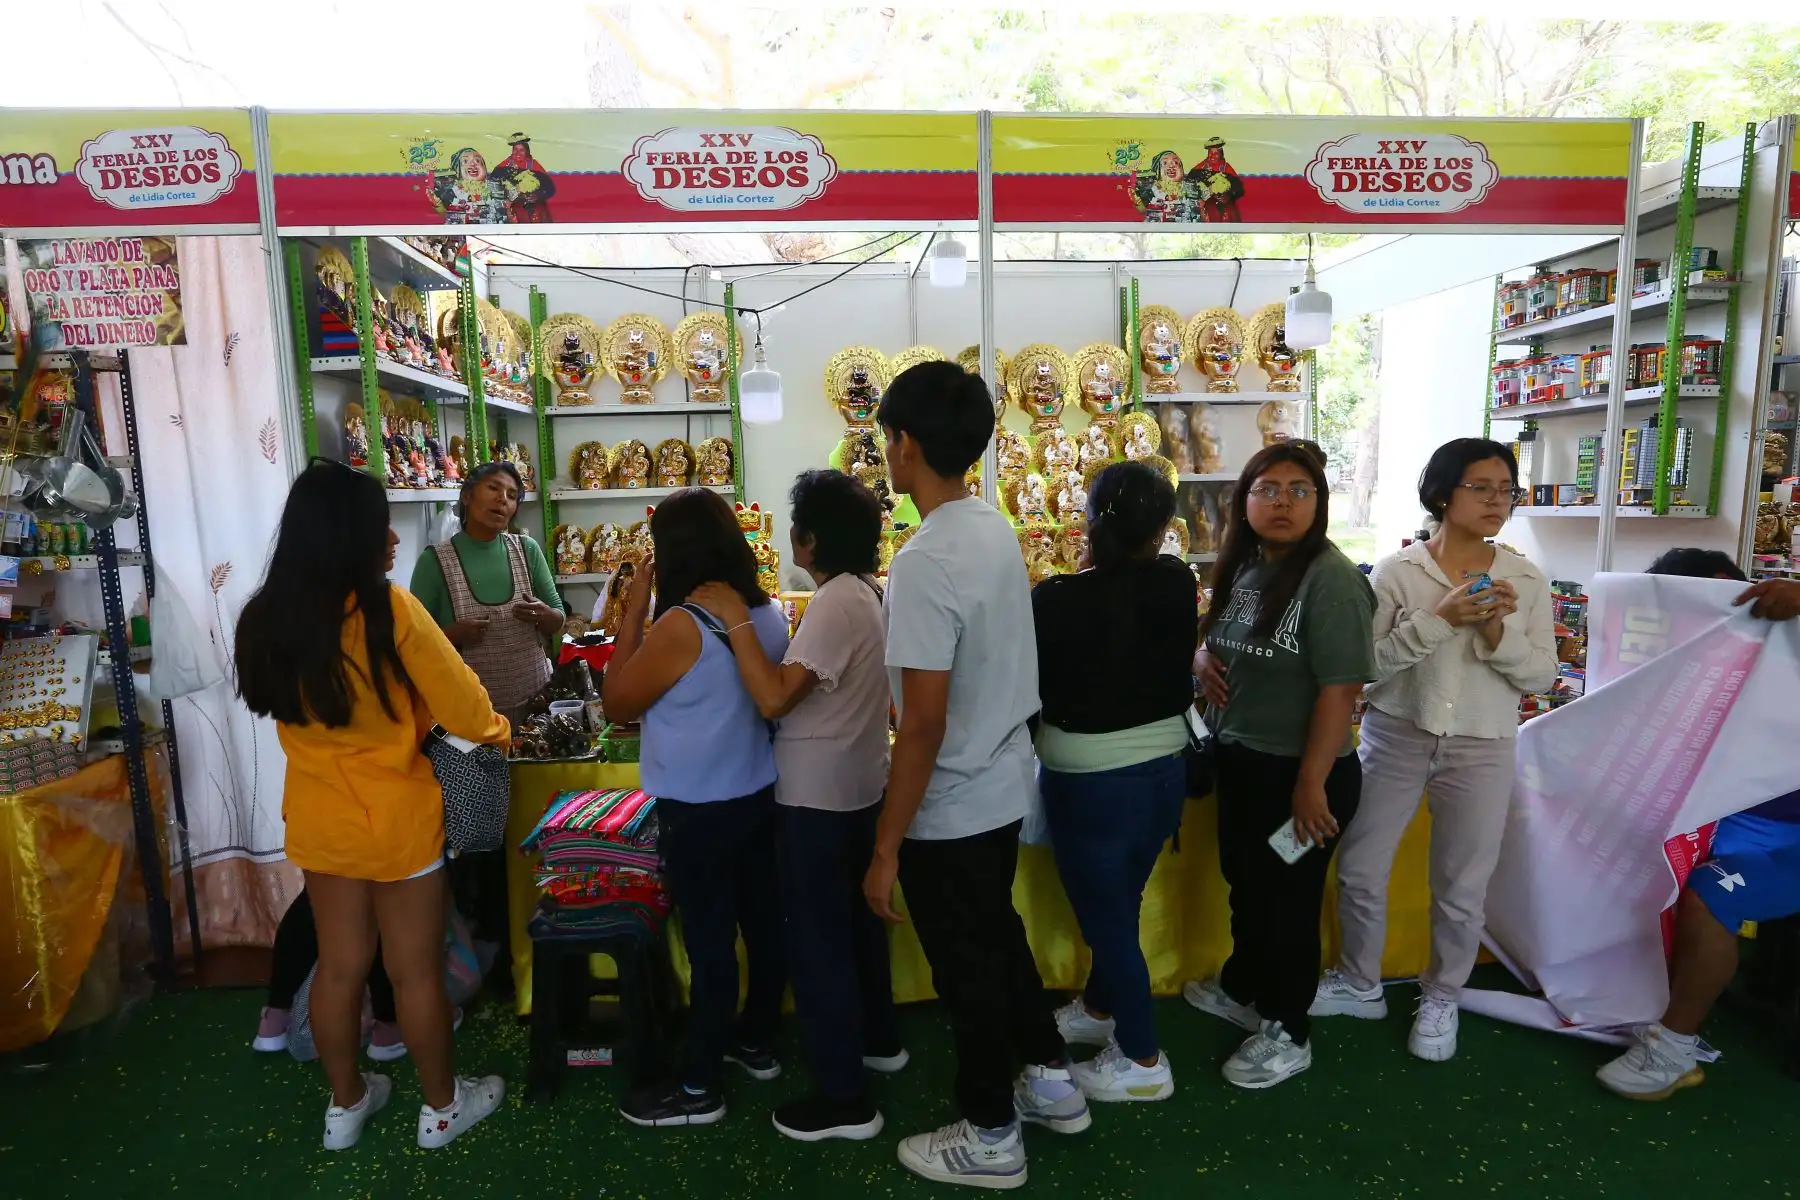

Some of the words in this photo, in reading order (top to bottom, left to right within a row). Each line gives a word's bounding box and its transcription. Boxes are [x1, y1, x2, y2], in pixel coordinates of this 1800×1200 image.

[130, 134, 173, 149] XXV
[700, 134, 753, 148] XXV
[1376, 140, 1427, 154] XXV
[92, 152, 149, 168] FERIA
[153, 151, 178, 163] DE
[184, 148, 218, 161] LOS
[646, 152, 720, 166] FERIA
[726, 152, 756, 165] DE
[764, 151, 808, 164] LOS
[1328, 157, 1392, 170] FERIA
[1399, 157, 1429, 170] DE
[1433, 157, 1473, 169] LOS
[99, 162, 221, 190] DESEOS
[652, 166, 809, 189] DESEOS
[1332, 172, 1473, 193] DESEOS
[129, 193, 140, 202] de
[142, 192, 164, 202] Lidia
[166, 191, 196, 200] Cortez
[688, 194, 703, 204] de
[706, 194, 733, 204] Lidia
[736, 194, 775, 204] Cortez
[1364, 197, 1376, 207] de
[1379, 197, 1404, 207] Lidia
[1406, 198, 1440, 207] Cortez
[52, 241, 119, 264] LAVADO
[122, 239, 143, 262] DE
[25, 269, 60, 293] ORO
[64, 269, 75, 291] Y
[78, 267, 129, 291] PLATA
[133, 265, 178, 289] PARA
[48, 296, 69, 319] LA
[62, 323, 94, 345] DEL
[97, 321, 156, 344] DINERO
[1216, 637, 1274, 657] FRANCISCO
